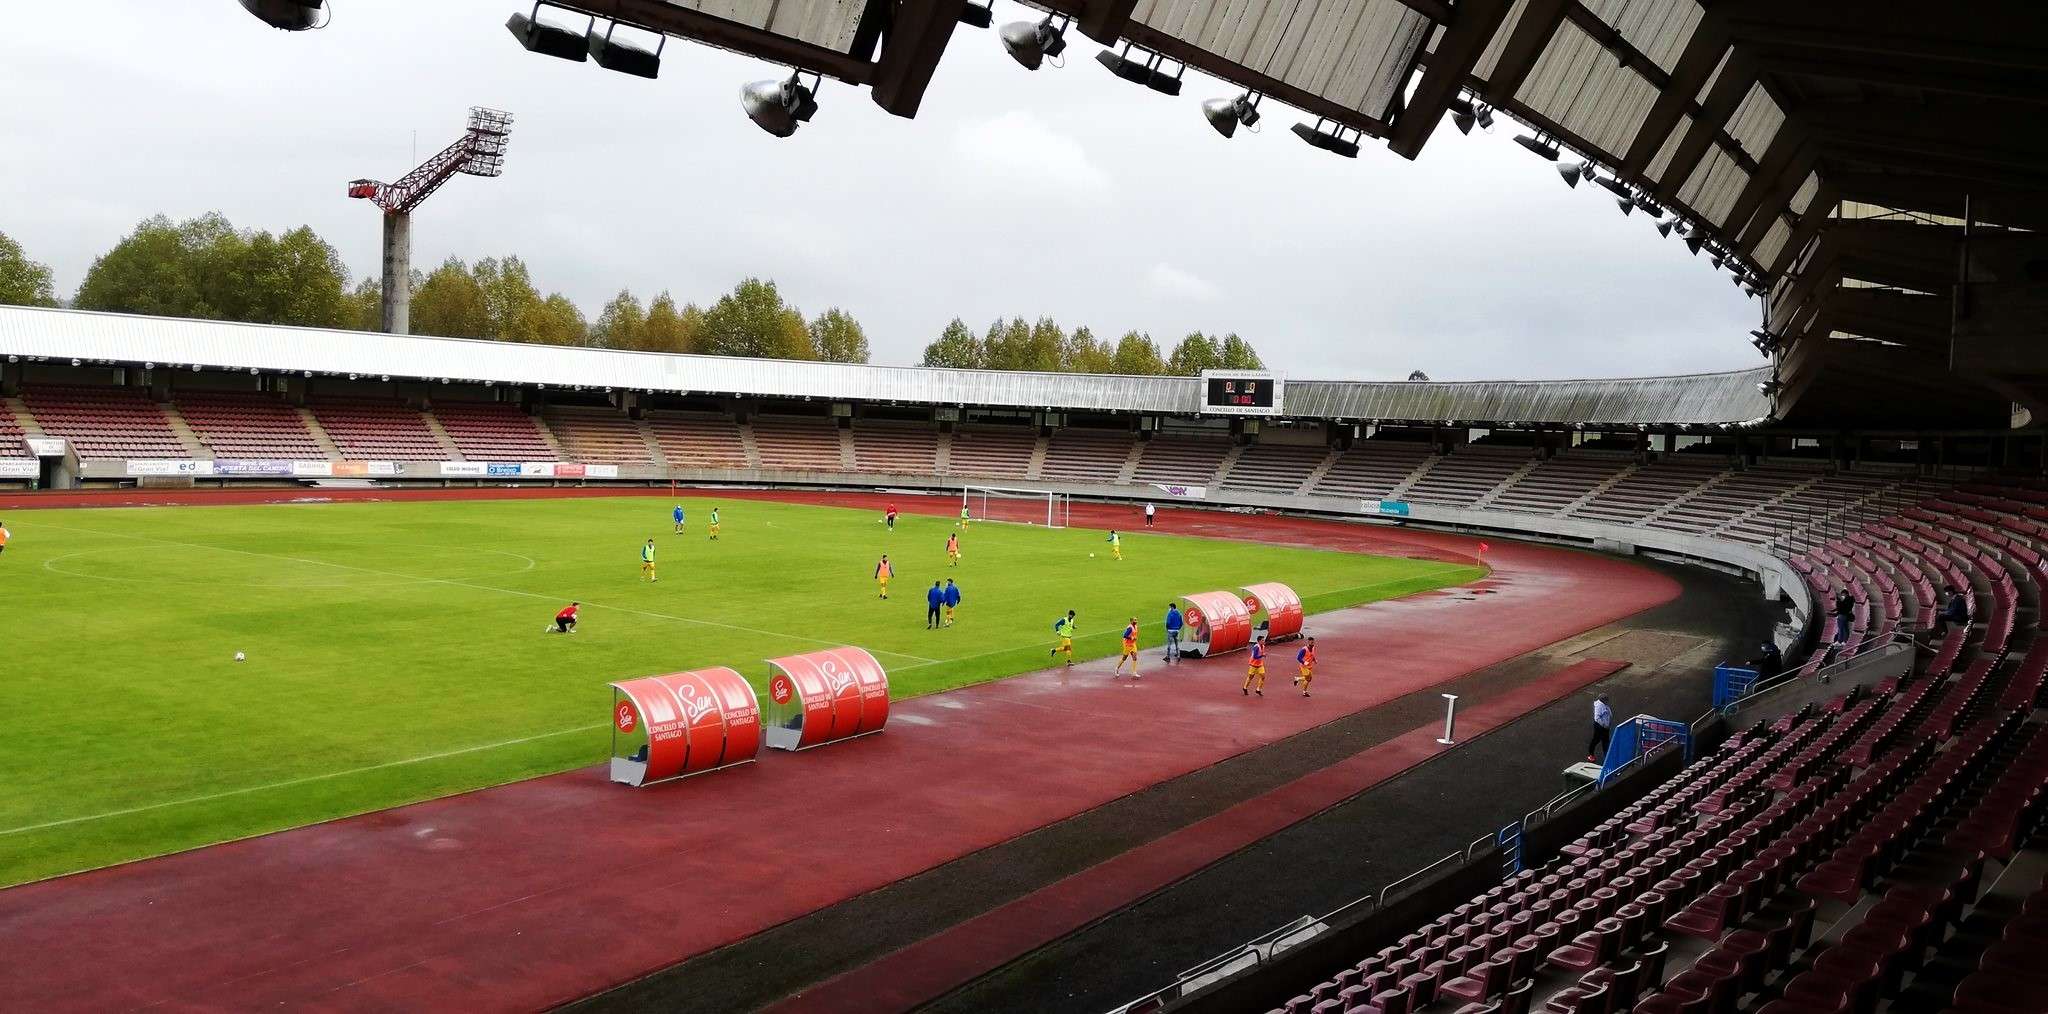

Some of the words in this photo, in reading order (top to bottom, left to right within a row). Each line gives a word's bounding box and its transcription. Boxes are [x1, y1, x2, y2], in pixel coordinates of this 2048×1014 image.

[822, 660, 852, 692] San
[775, 679, 788, 698] San
[865, 690, 885, 700] SANTIAGO
[678, 684, 715, 719] San
[803, 694, 825, 704] CONCELLO
[724, 708, 751, 720] CONCELLO
[750, 707, 759, 716] DE
[808, 702, 830, 712] SANTIAGO
[619, 705, 633, 729] San
[730, 715, 755, 727] SANTIAGO
[649, 723, 676, 735] CONCELLO
[676, 721, 687, 729] DE
[655, 730, 682, 742] SANTIAGO
